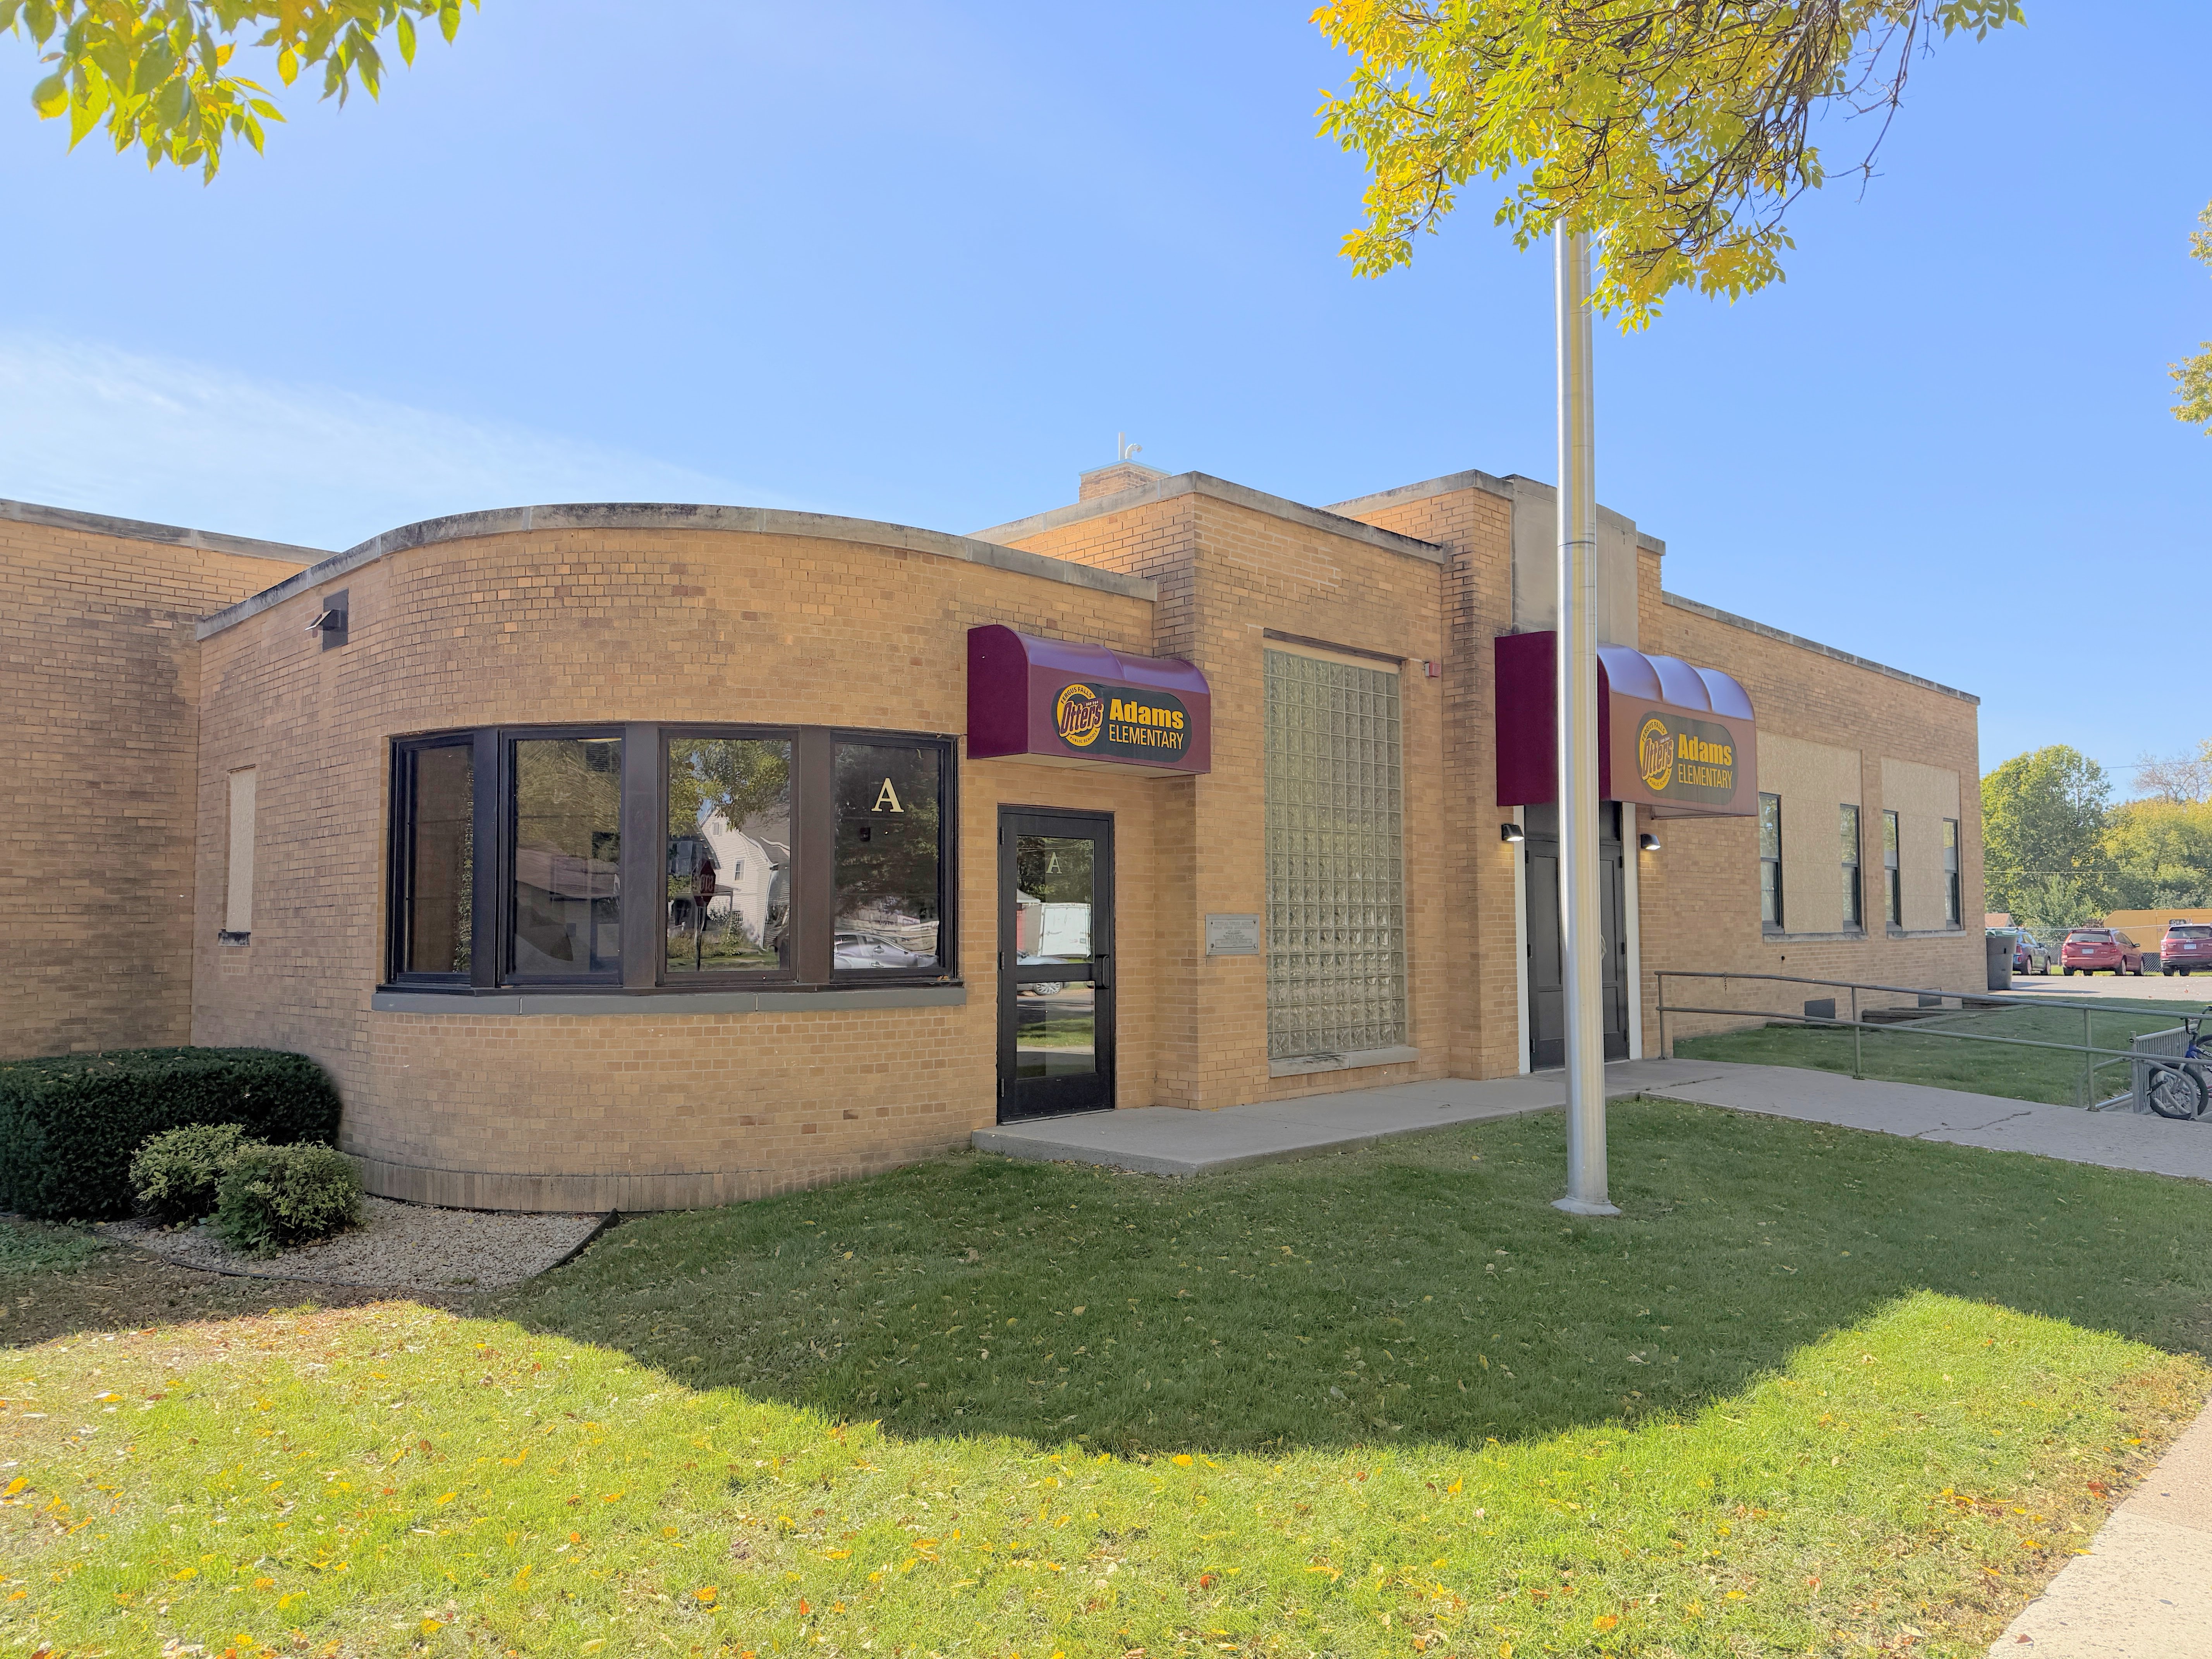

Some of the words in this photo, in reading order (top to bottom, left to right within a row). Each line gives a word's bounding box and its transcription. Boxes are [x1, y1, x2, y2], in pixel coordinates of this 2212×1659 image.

[1061, 687, 1077, 704] FERGUS
[1078, 687, 1092, 698] FALLS
[1060, 701, 1104, 737] Otters
[1109, 699, 1184, 730] Adams
[1109, 724, 1184, 750] ELEMENTARY
[1642, 722, 1654, 742] FERGUS
[1654, 721, 1665, 734] FALLS
[1642, 738, 1674, 780] Otters
[1678, 733, 1733, 766] Adams
[1678, 763, 1733, 789] ELEMENTARY
[871, 778, 904, 812] A
